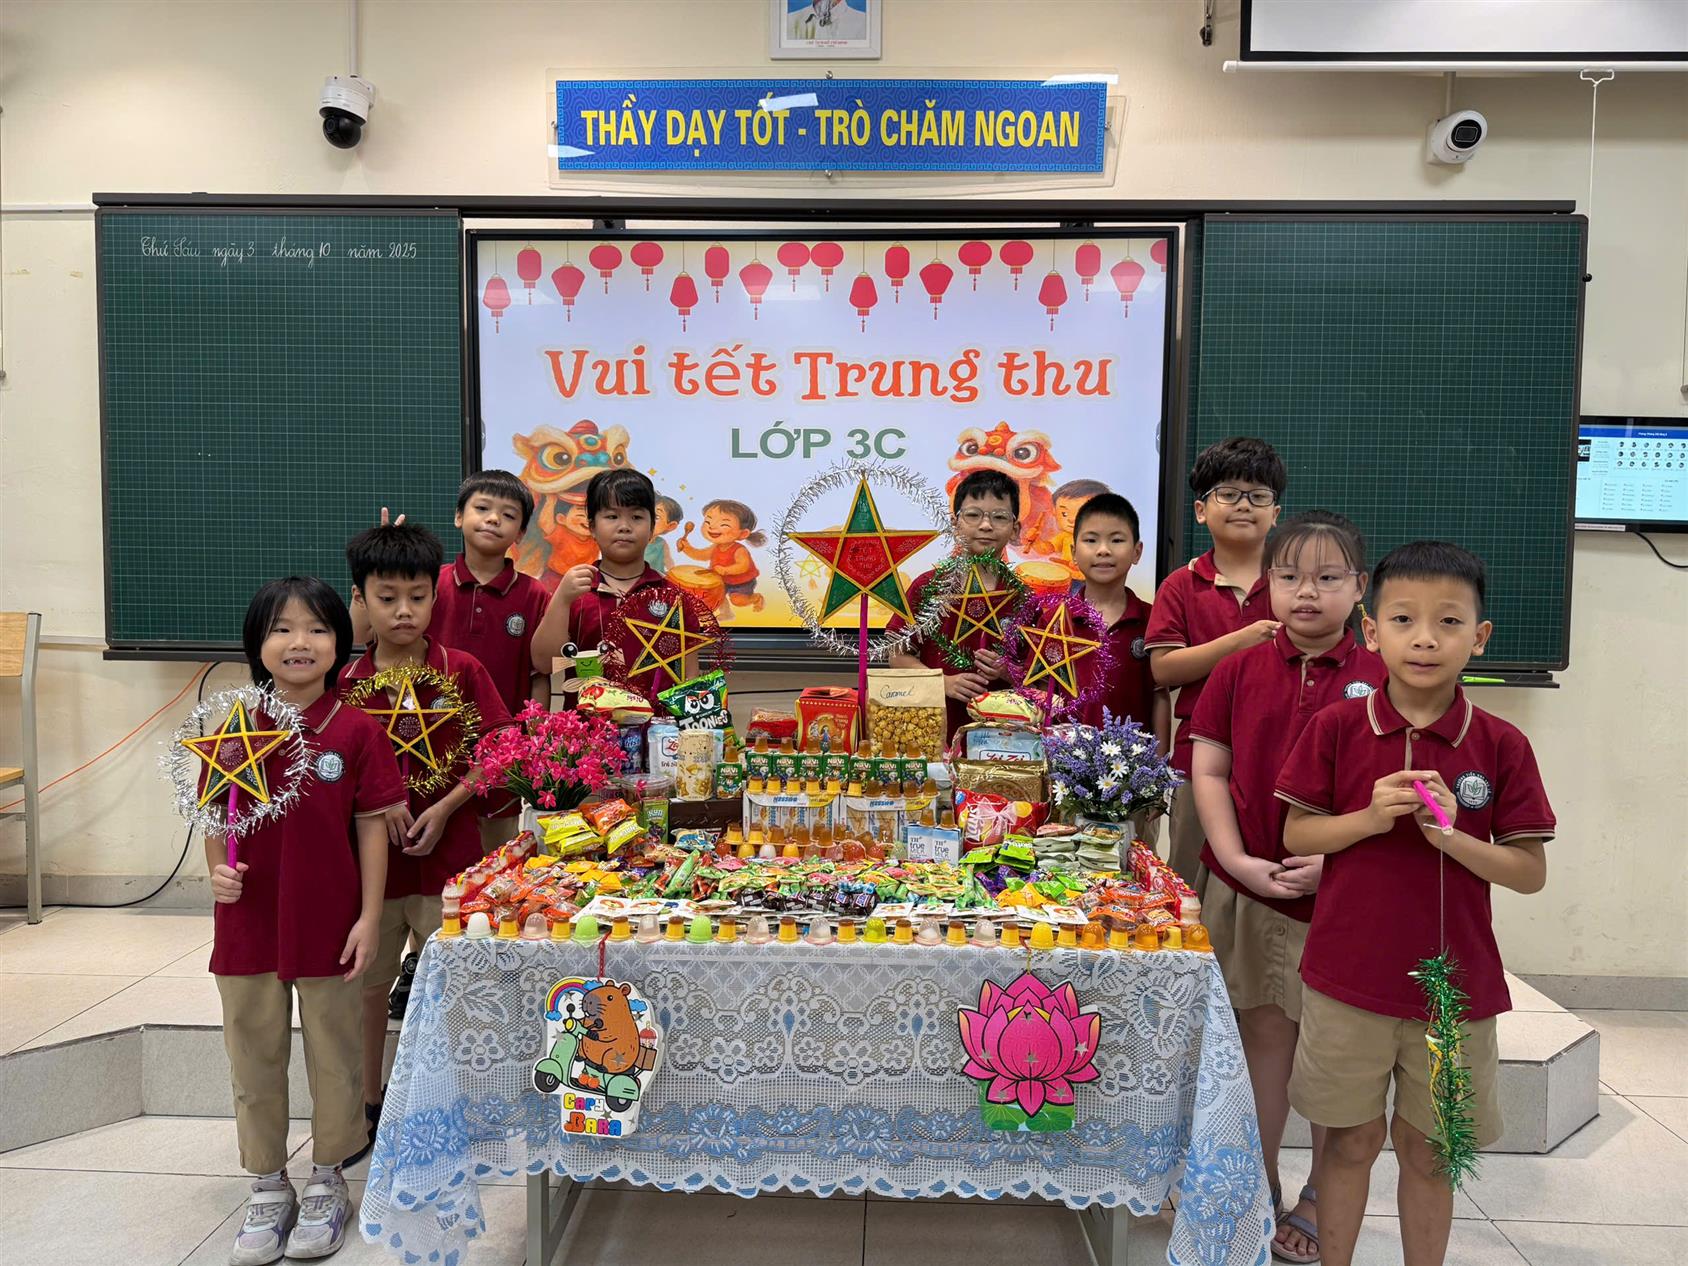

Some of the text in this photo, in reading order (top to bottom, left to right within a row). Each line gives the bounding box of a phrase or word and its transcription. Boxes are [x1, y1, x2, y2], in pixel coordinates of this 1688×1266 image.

[581, 94, 656, 146] THẦY
[667, 109, 727, 157] DẠY
[815, 99, 871, 147] TRÒ
[880, 99, 965, 147] CHĂM
[975, 110, 1080, 148] NGOAN
[247, 240, 255, 257] 3
[319, 241, 331, 258] 10
[347, 242, 383, 258] năm
[388, 241, 417, 259] 2025
[544, 344, 1113, 403] Vui tết Trung thu
[731, 420, 907, 461] LỚP 3C
